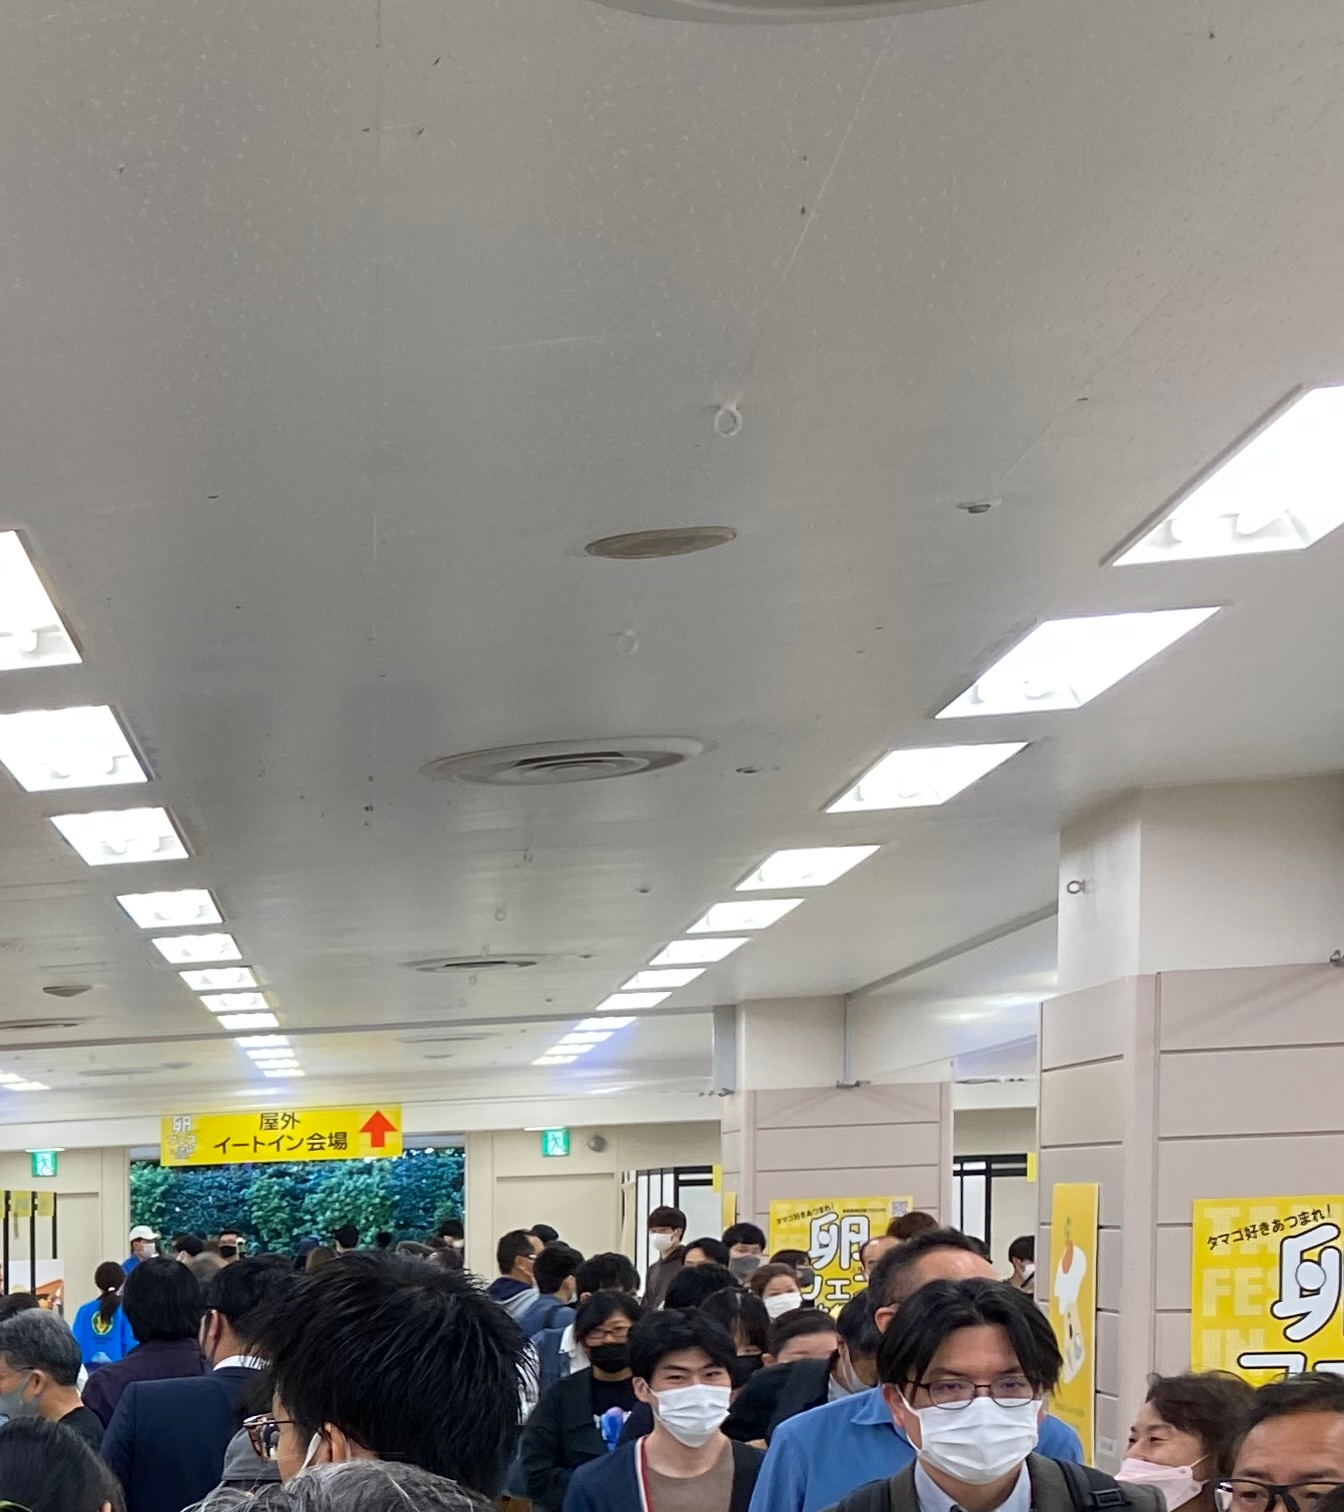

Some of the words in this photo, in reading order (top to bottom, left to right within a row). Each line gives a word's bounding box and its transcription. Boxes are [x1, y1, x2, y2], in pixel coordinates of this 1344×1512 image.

[259, 1111, 301, 1131] 屋外
[213, 1132, 348, 1155] イートイン会場
[808, 1212, 870, 1270] 卵
